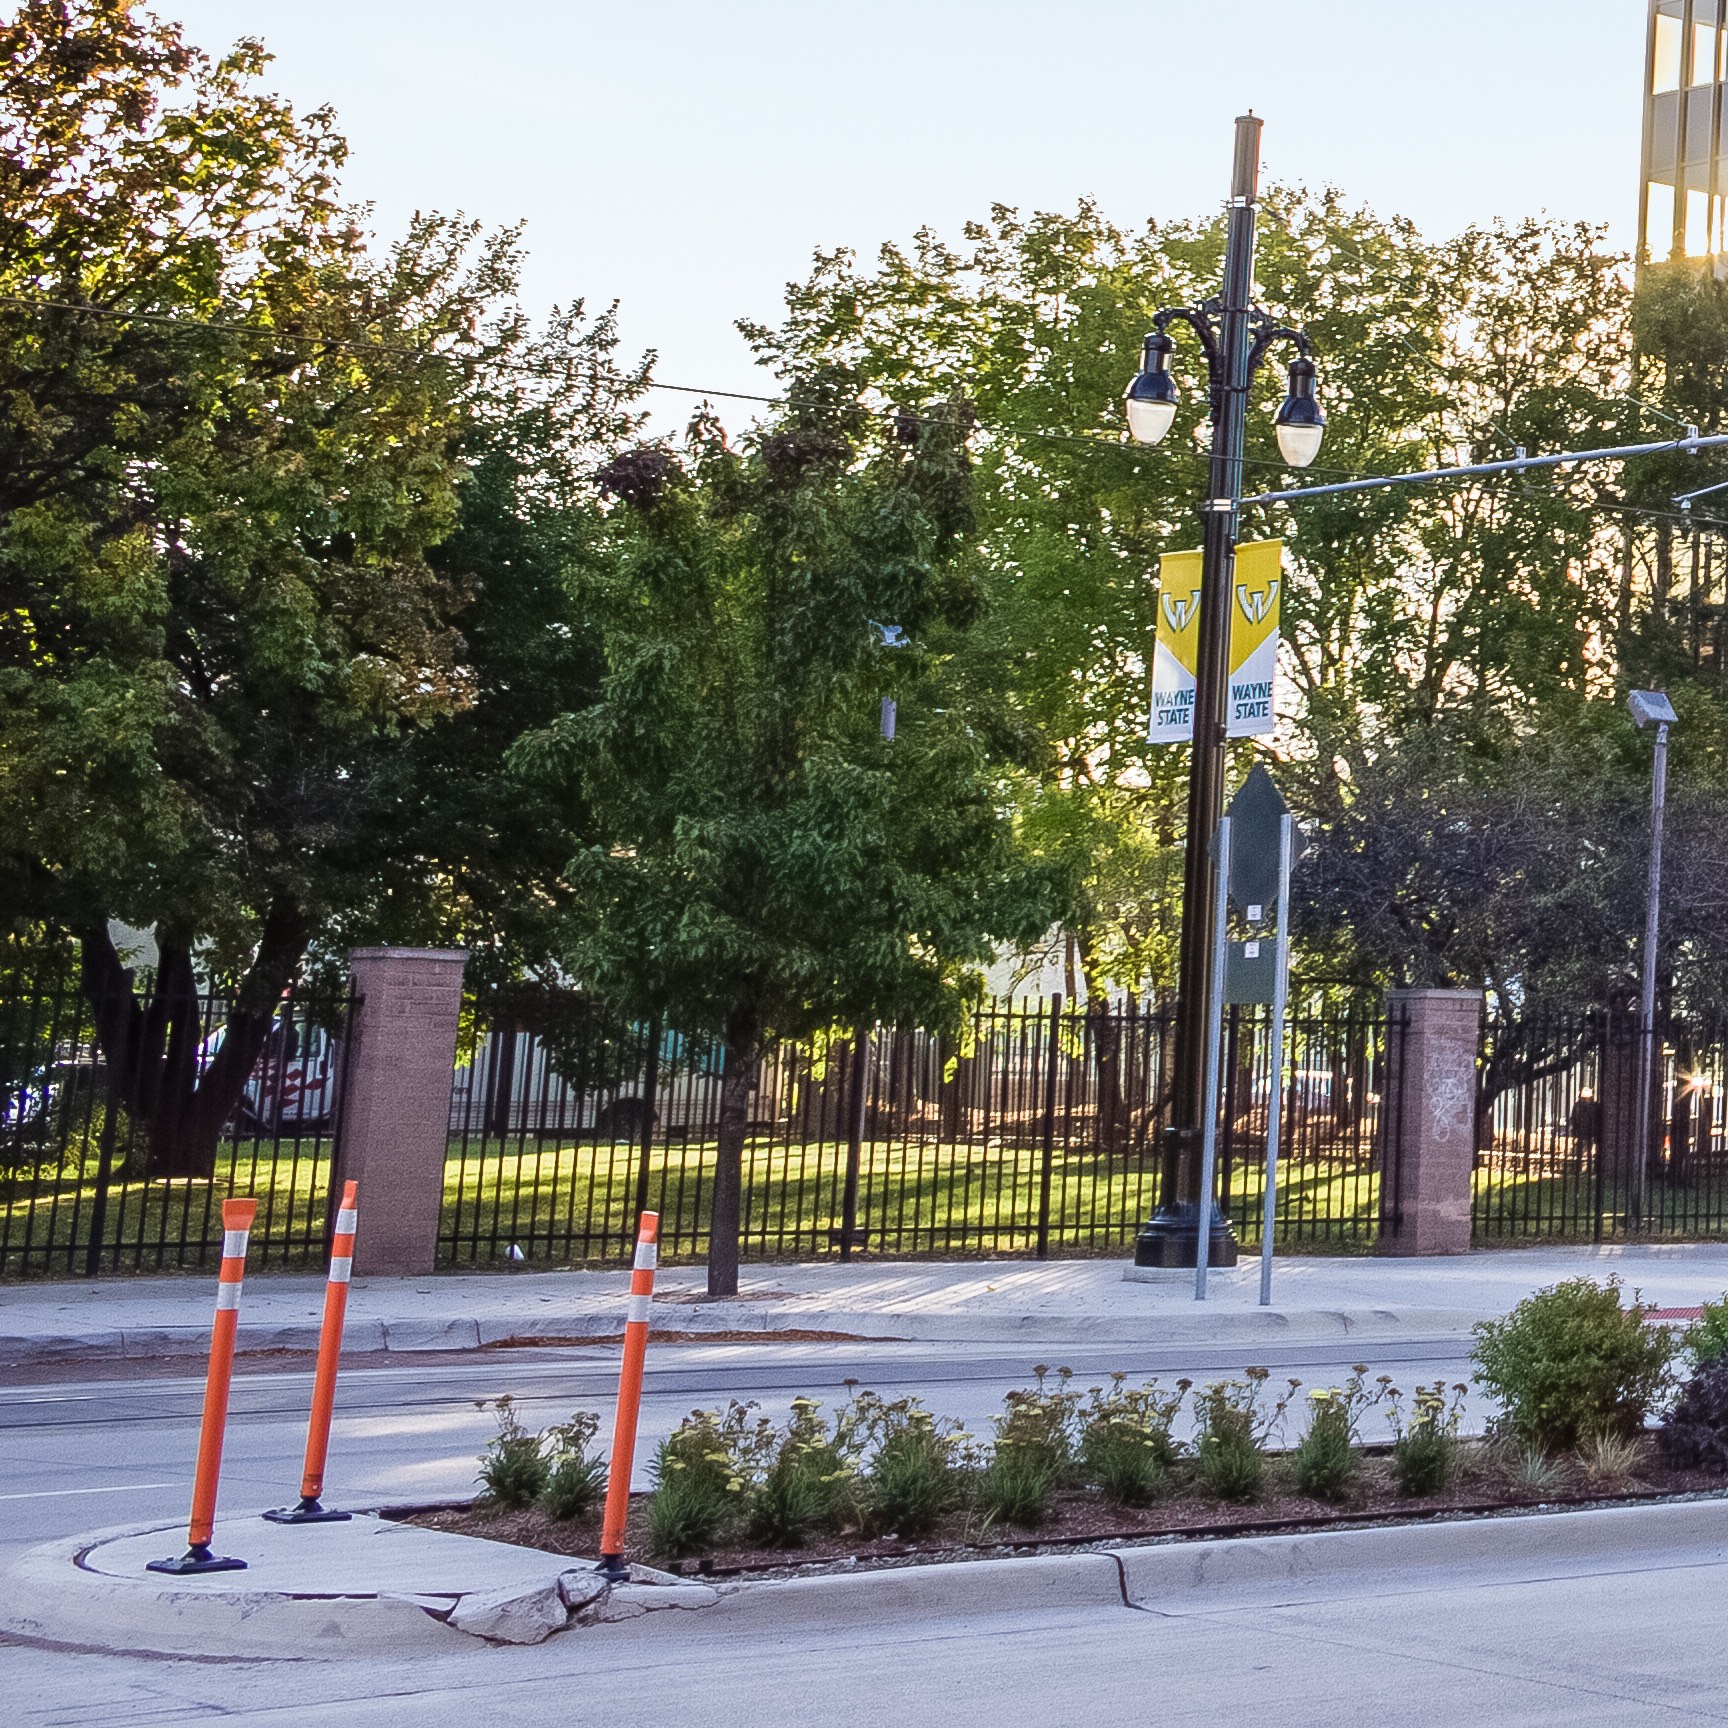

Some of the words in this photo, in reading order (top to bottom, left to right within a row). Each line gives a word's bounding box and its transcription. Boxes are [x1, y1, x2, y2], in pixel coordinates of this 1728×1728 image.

[1161, 590, 1201, 632] W
[1236, 580, 1279, 624] W
[1155, 689, 1195, 707] WAYNE
[1232, 681, 1273, 701] WAYNE
[1157, 708, 1190, 726] STATE
[1235, 701, 1269, 720] STATE
